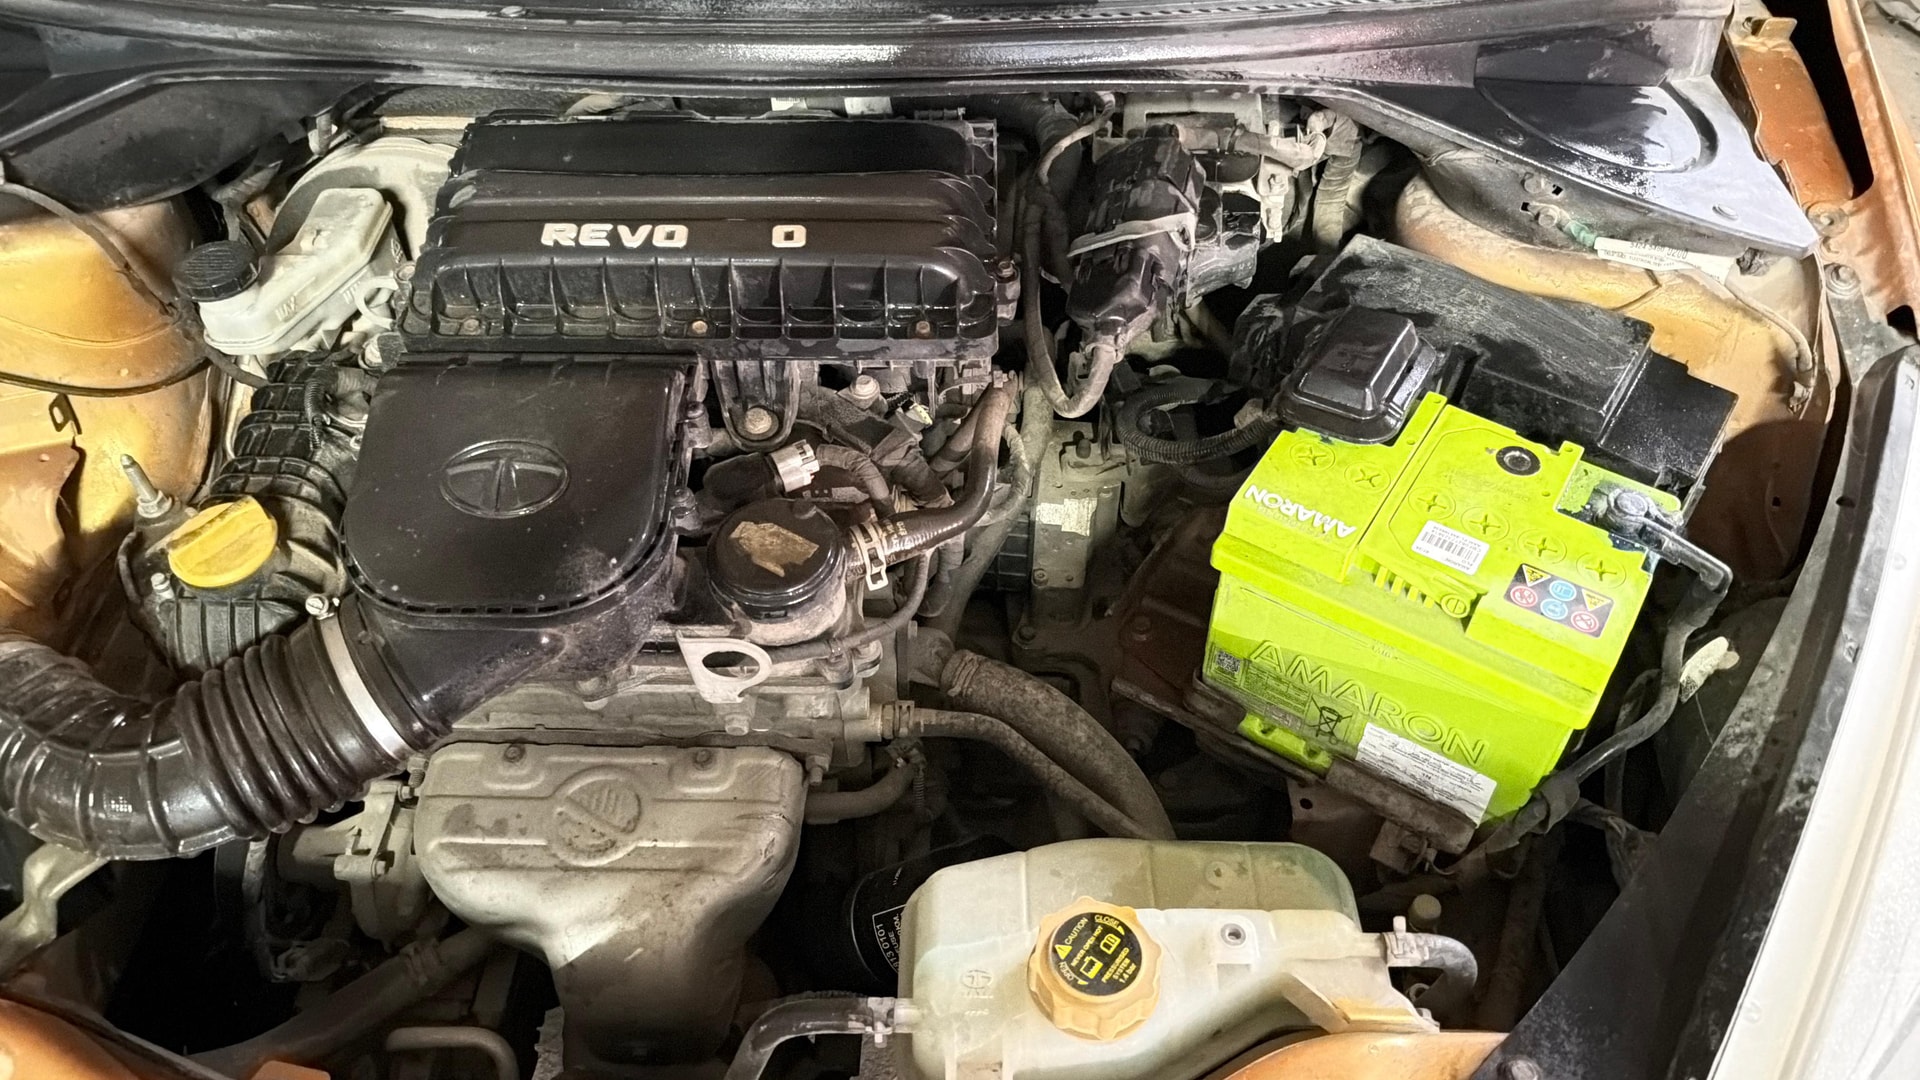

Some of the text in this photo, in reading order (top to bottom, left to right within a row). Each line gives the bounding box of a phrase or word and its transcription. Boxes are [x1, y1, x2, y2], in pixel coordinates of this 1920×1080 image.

[540, 222, 689, 249] REVO
[1245, 486, 1357, 537] AMARON
[1250, 639, 1490, 767] AMARON
[1064, 917, 1089, 945] CAUTION
[1094, 914, 1120, 927] CLOSE
[876, 923, 890, 949] 0101
[1059, 961, 1075, 981] OPEN
